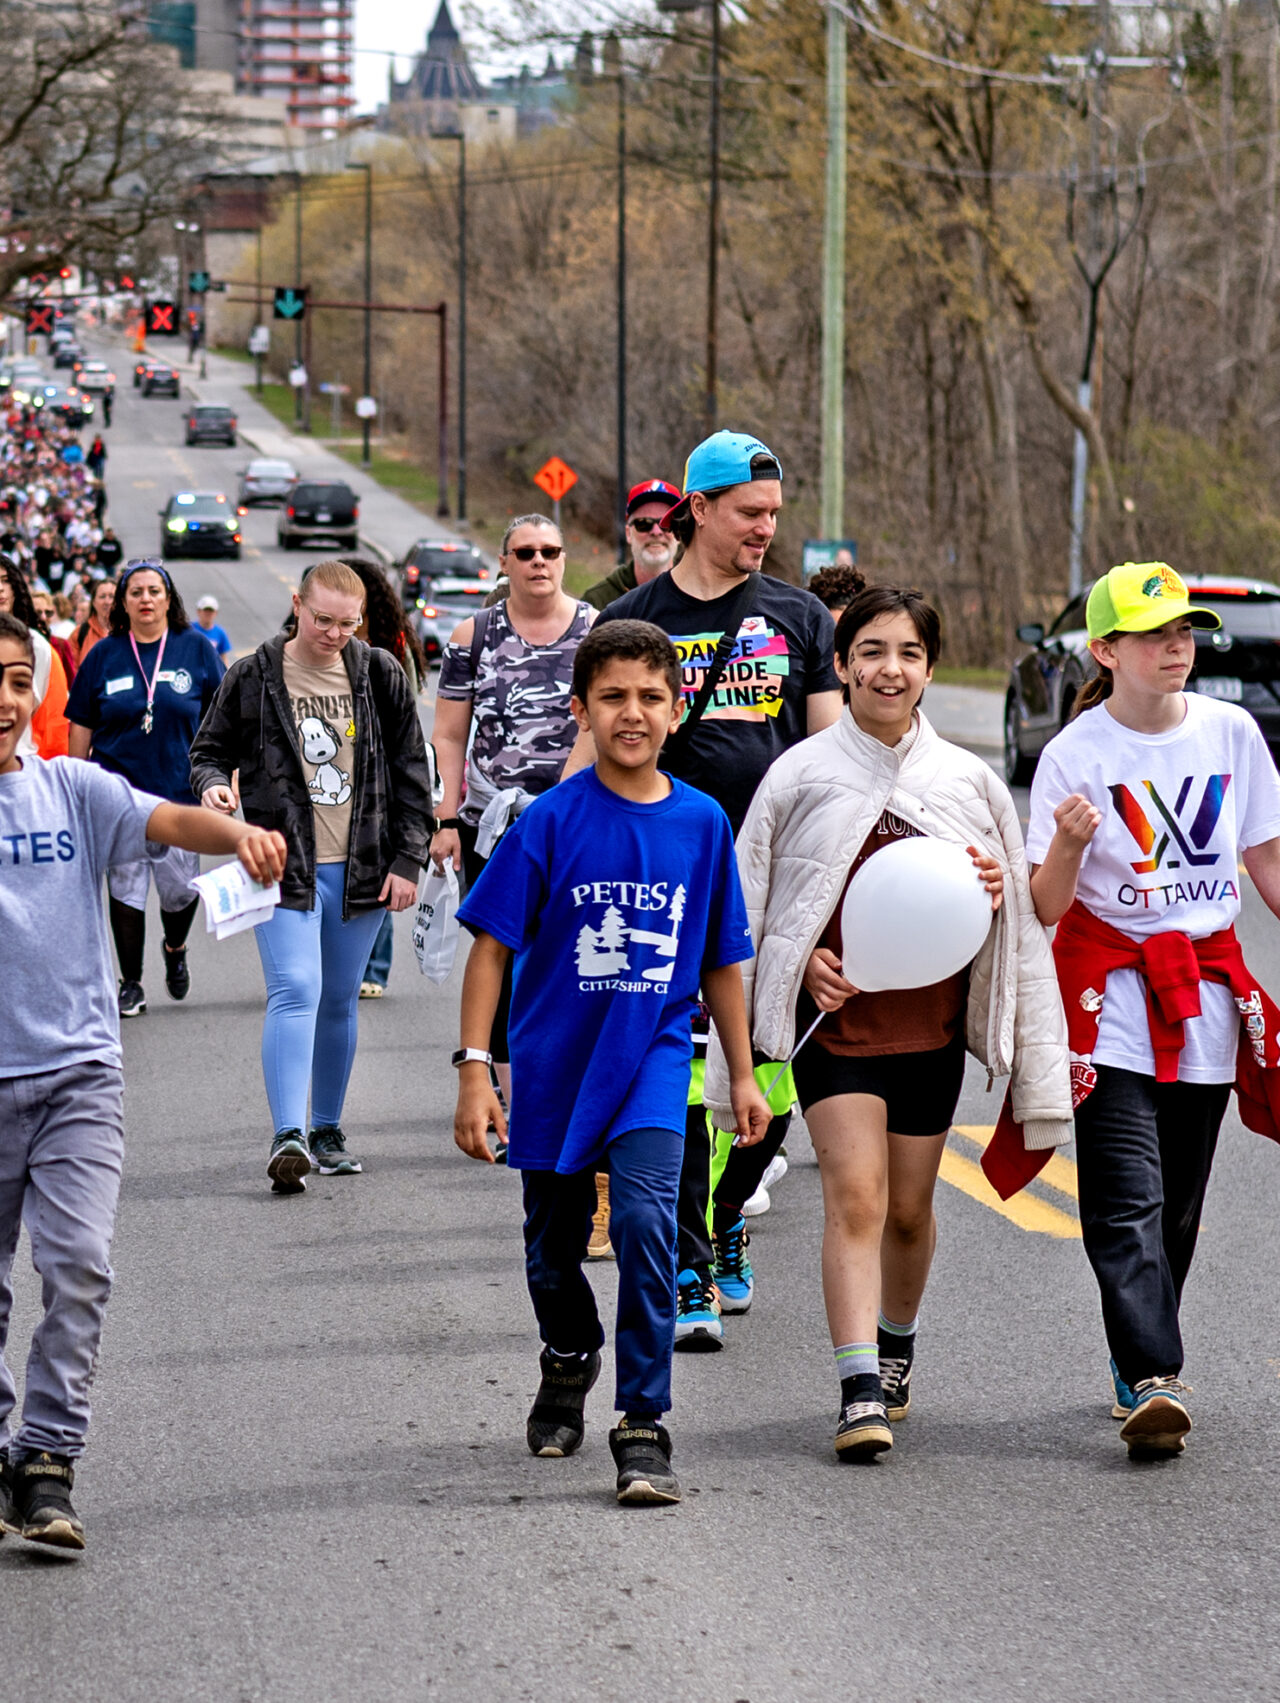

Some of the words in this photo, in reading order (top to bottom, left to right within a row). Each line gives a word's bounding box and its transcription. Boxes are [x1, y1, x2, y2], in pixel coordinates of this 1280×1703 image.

[712, 685, 779, 708] LINES
[571, 881, 669, 911] PETES
[1118, 880, 1239, 909] OTTAWA
